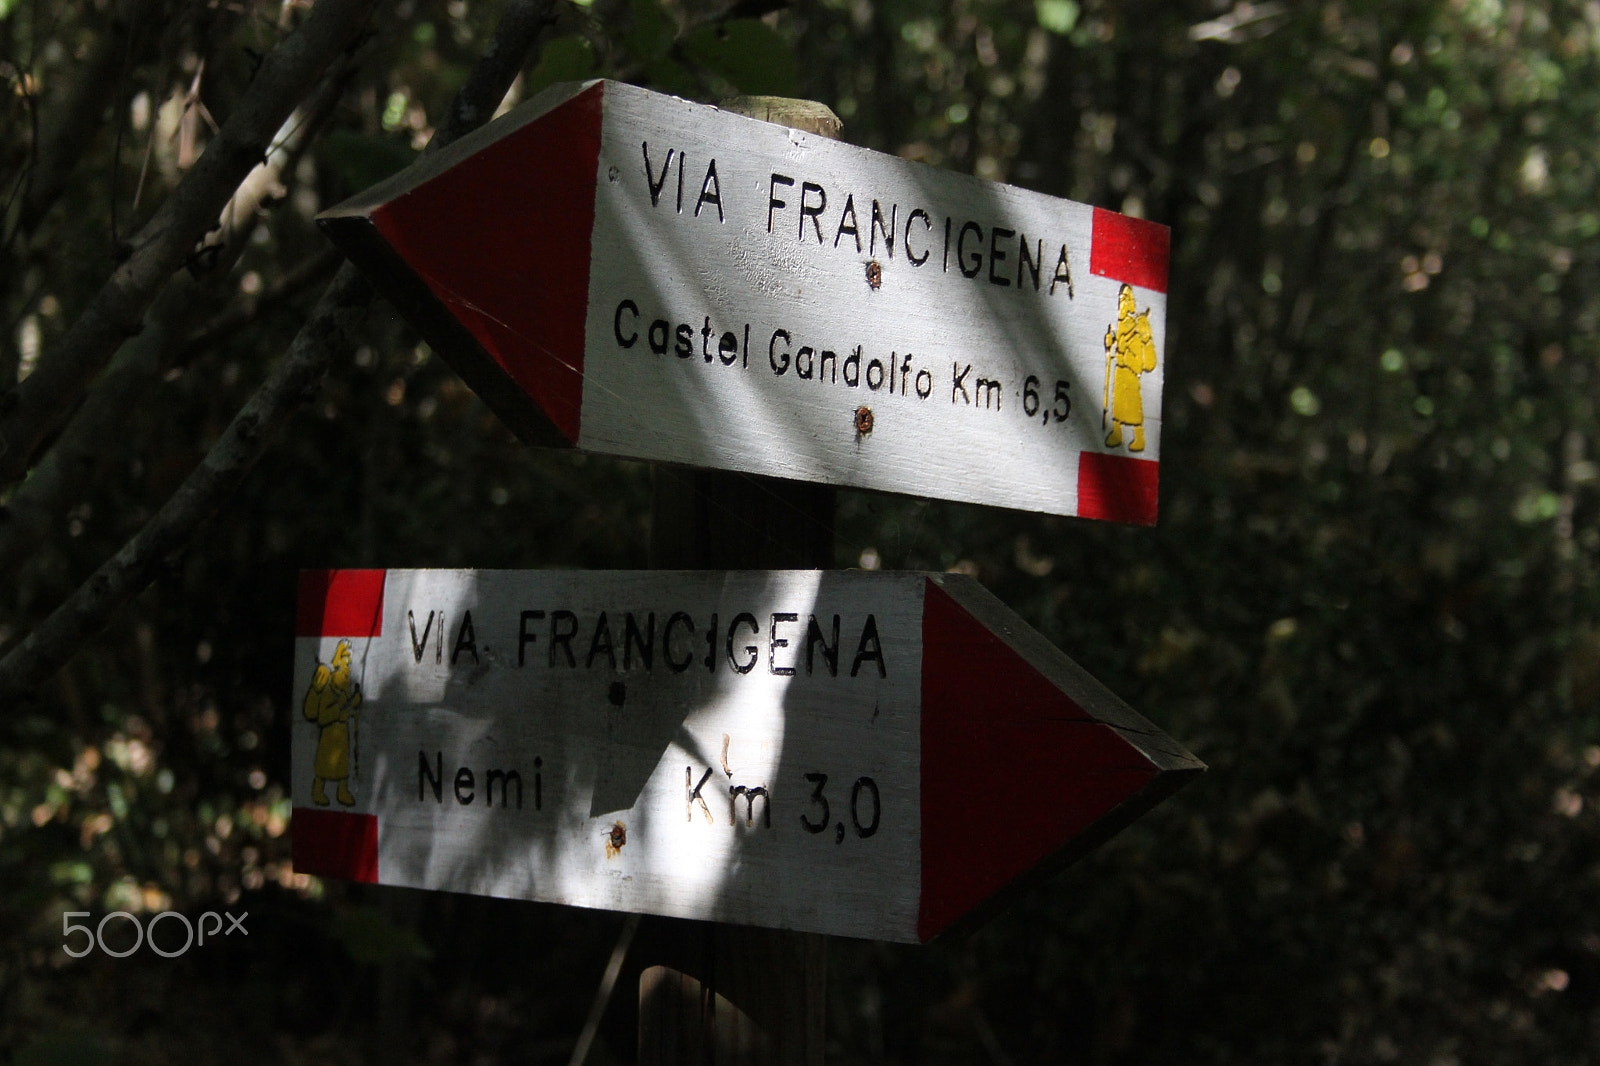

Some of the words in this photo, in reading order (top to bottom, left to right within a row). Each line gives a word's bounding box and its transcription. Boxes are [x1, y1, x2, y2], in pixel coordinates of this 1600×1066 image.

[642, 141, 725, 224] VIA
[767, 172, 1074, 300] FRANCIGENA
[613, 299, 749, 369] Castel
[768, 328, 932, 400] Gandolfo
[952, 361, 1002, 412] Km
[1022, 375, 1072, 424] 6,5
[407, 609, 479, 665] VIA
[517, 610, 886, 679] FRANCIGENA
[418, 750, 543, 811] Nemi
[685, 766, 771, 829] Km
[800, 772, 882, 845] 3,0
